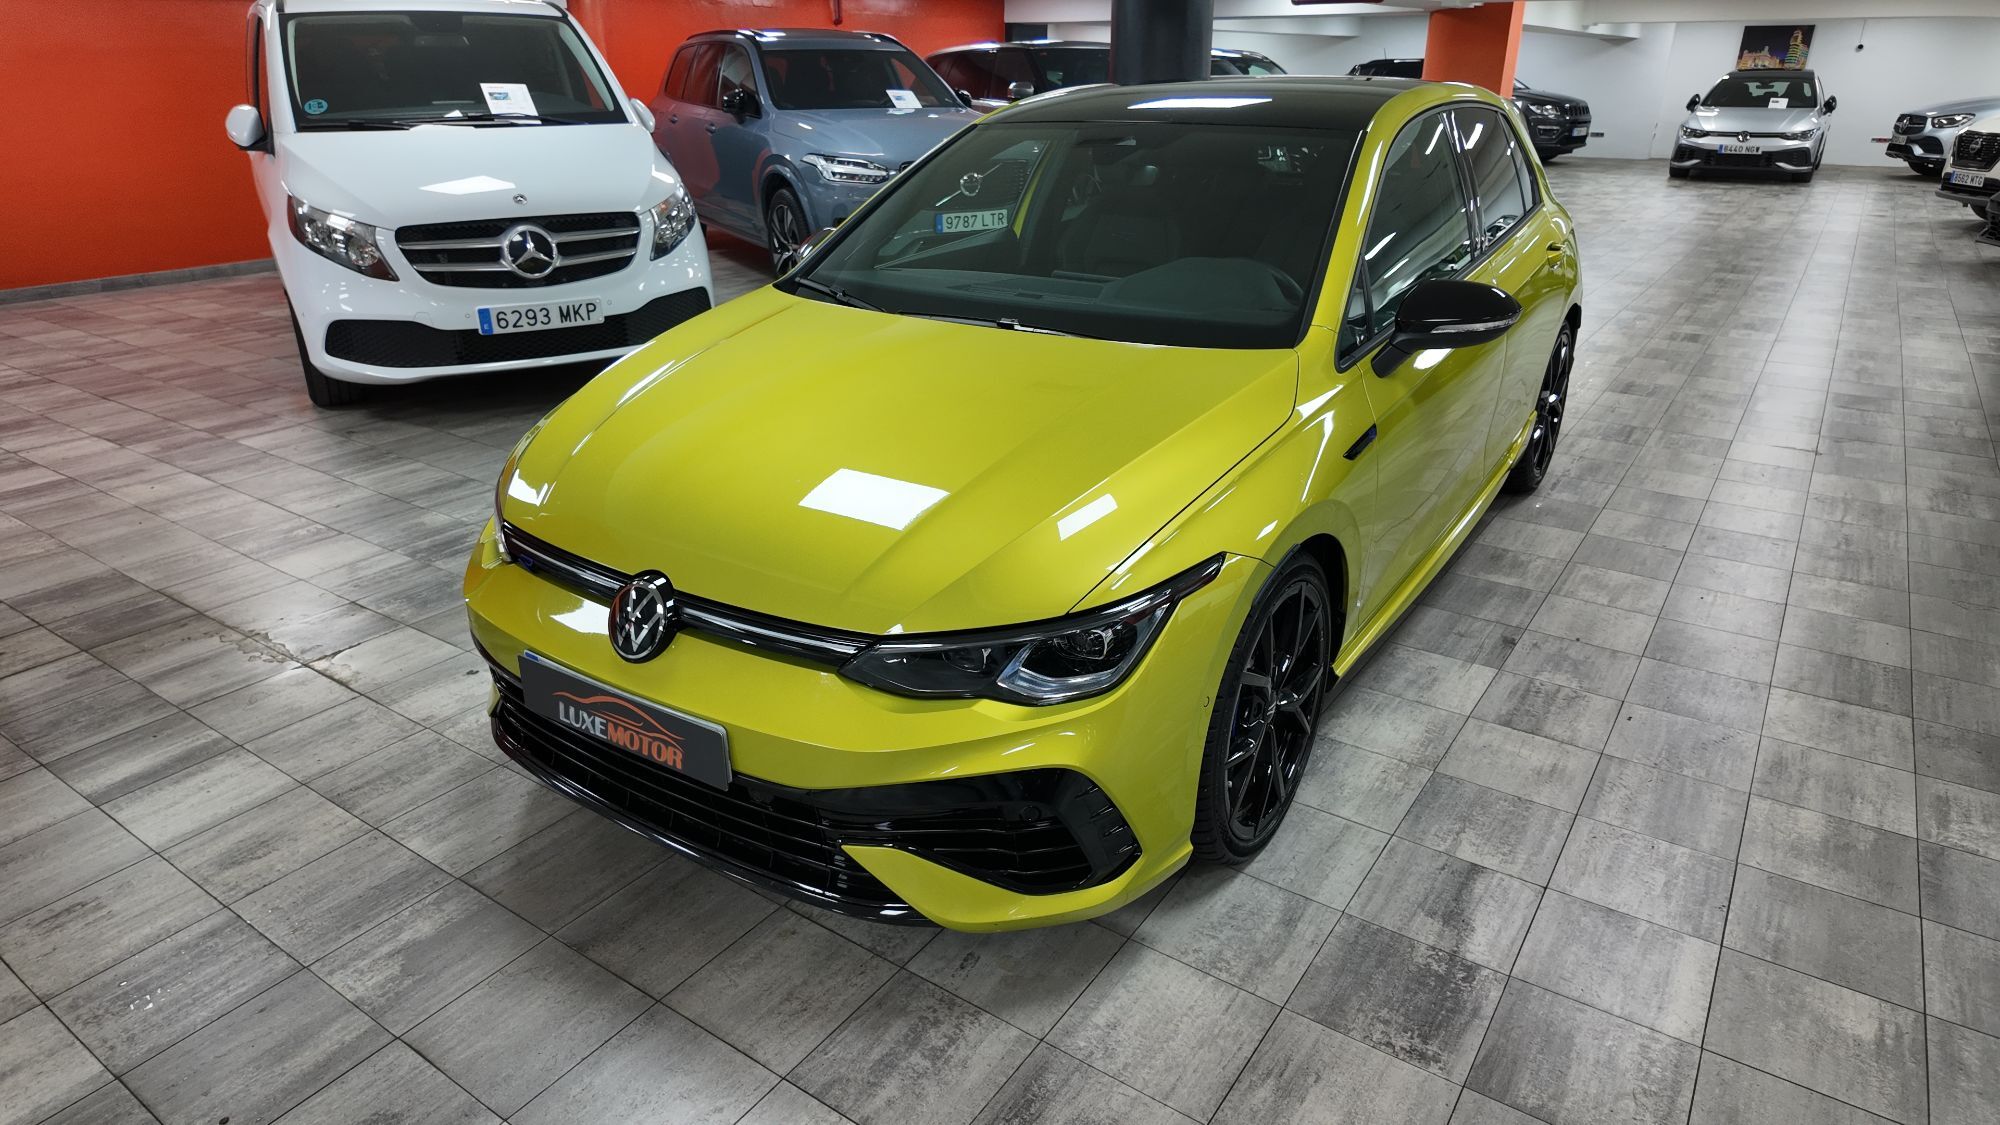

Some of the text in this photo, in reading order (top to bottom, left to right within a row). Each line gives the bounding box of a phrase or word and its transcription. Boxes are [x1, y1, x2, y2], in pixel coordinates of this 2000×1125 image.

[945, 212, 1005, 230] 9787 LTR
[495, 307, 552, 329] 6293
[558, 302, 597, 323] MKP
[558, 700, 684, 771] LUXEMOTOR
